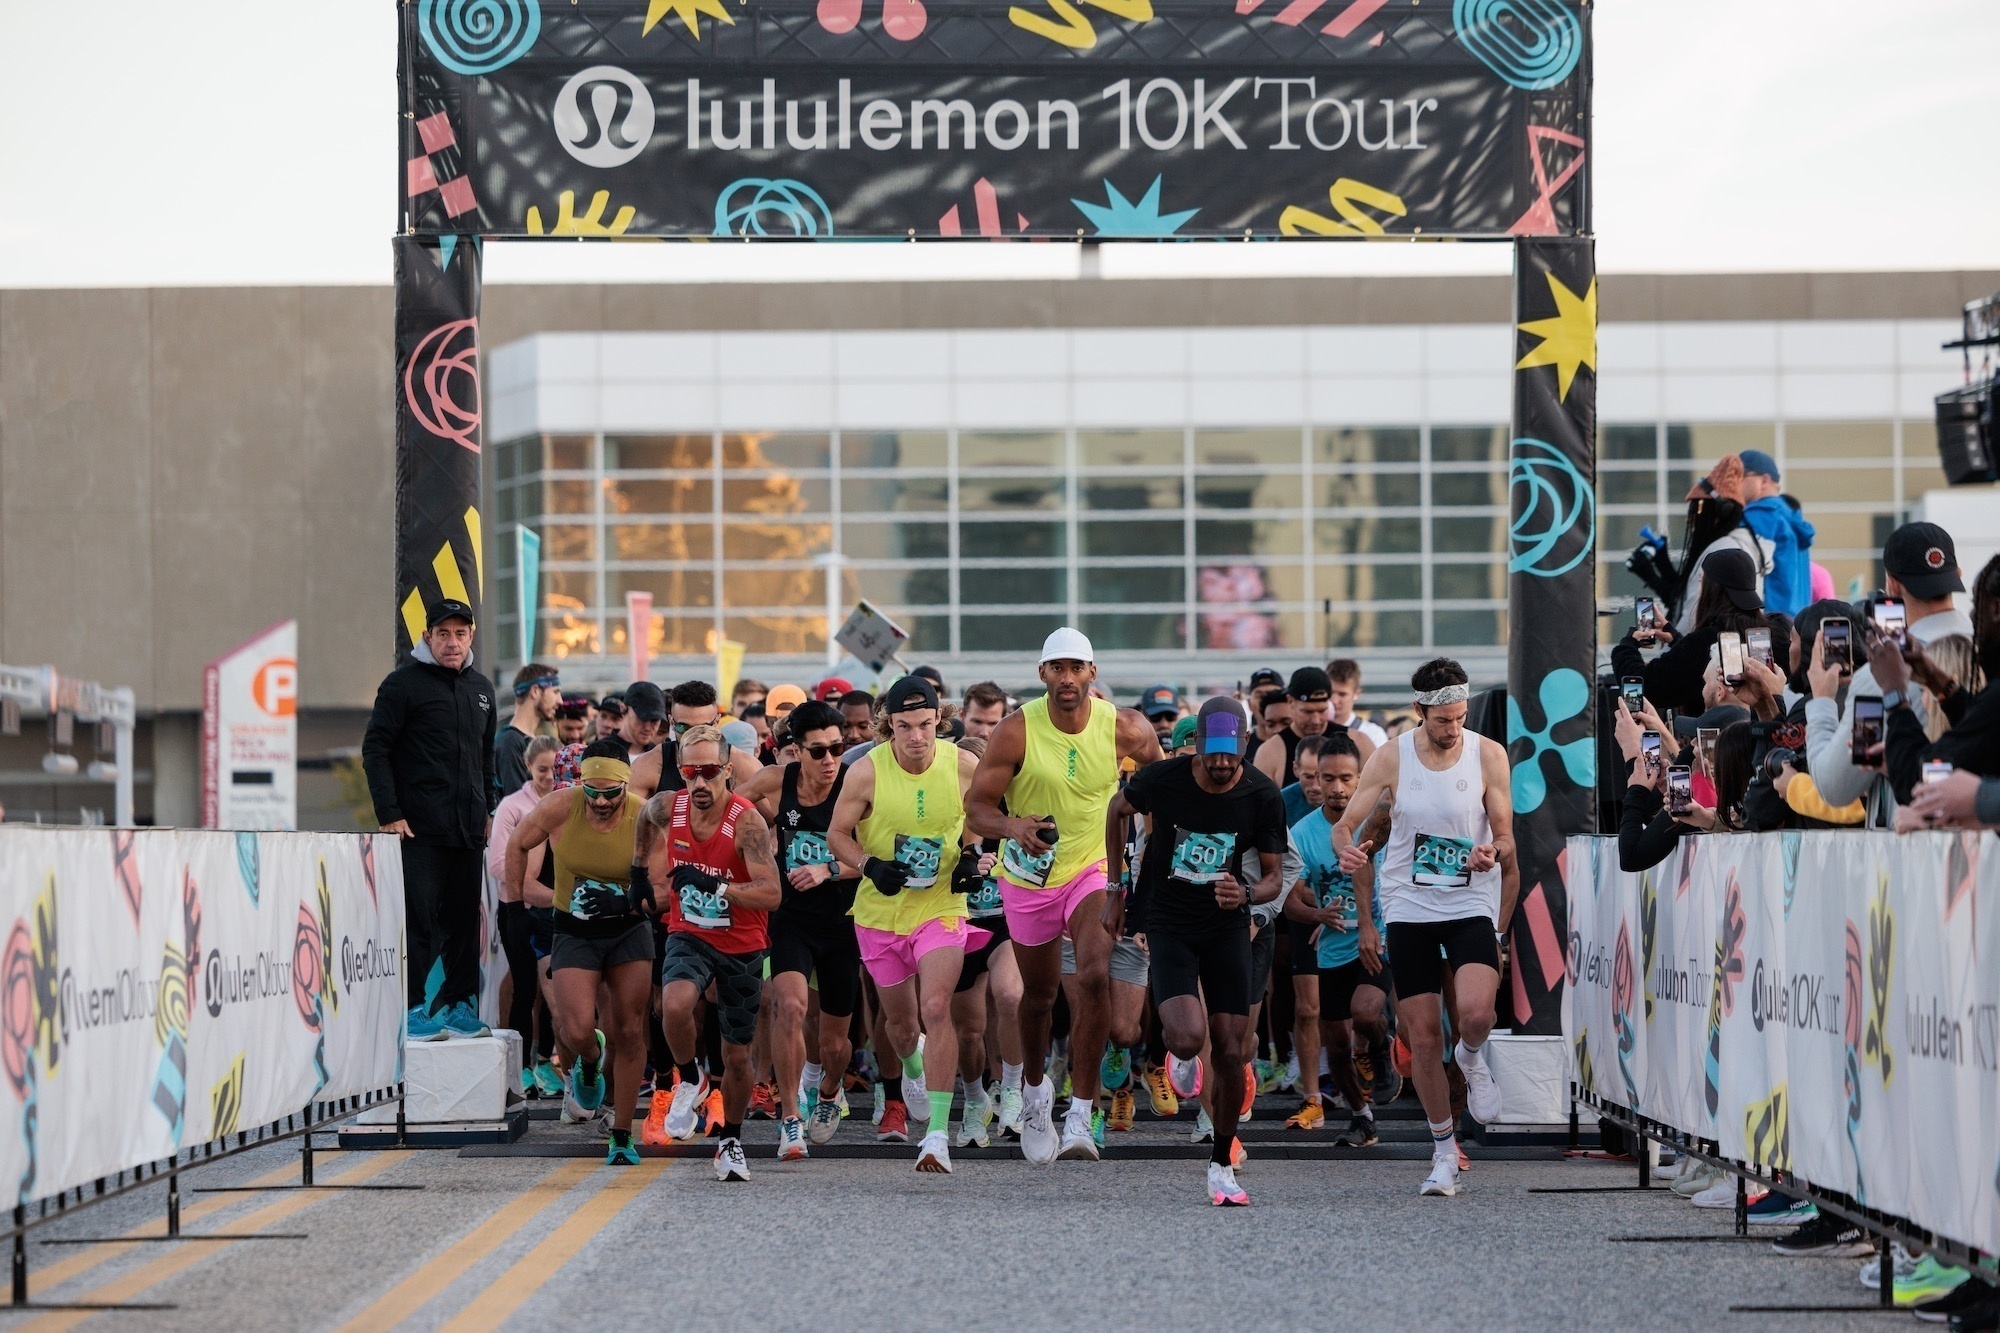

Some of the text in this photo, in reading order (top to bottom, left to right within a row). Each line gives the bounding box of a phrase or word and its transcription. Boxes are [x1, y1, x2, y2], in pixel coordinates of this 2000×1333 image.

[687, 77, 1438, 151] lululemon 10K Tour
[264, 666, 297, 713] P
[788, 842, 835, 861] 1014
[902, 848, 940, 869] 725
[1178, 842, 1228, 865] 1501
[1416, 844, 1470, 869] 2186
[1179, 870, 1210, 880] JARED
[680, 887, 729, 911] 2326
[1791, 972, 1821, 1032] 10K
[1789, 1199, 1810, 1211] HOKA
[1836, 1228, 1861, 1243] HOKA
